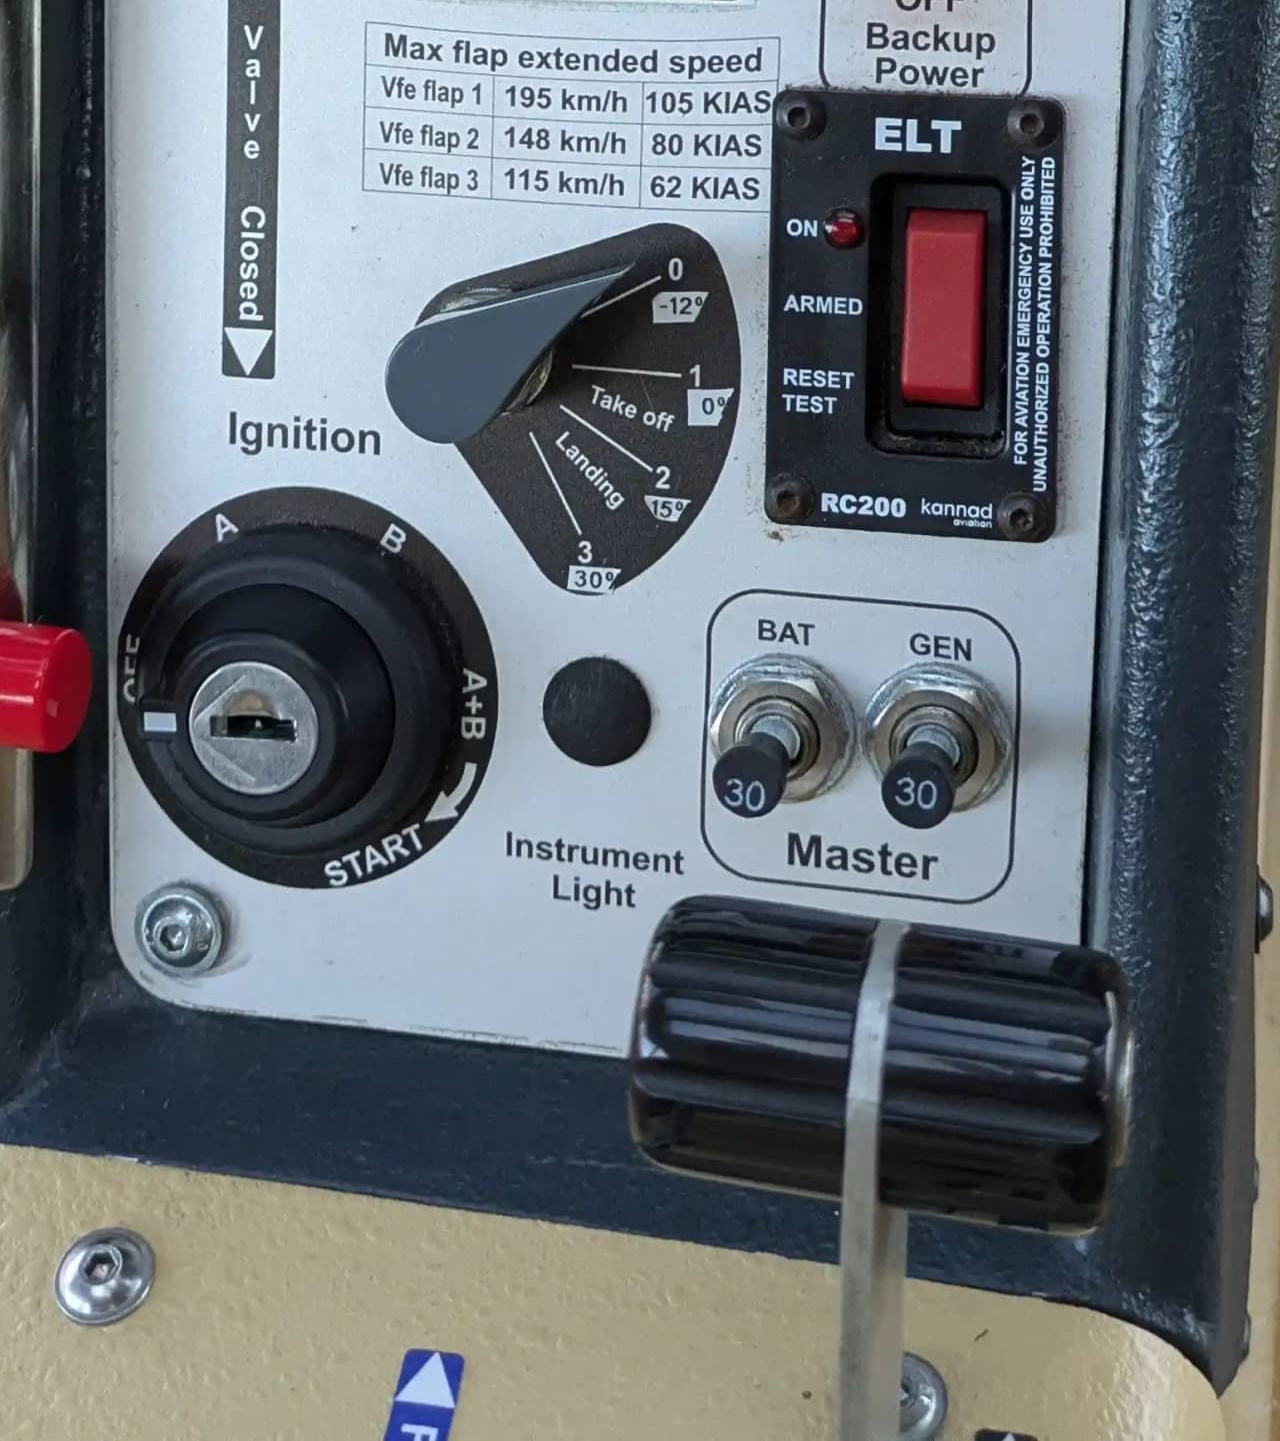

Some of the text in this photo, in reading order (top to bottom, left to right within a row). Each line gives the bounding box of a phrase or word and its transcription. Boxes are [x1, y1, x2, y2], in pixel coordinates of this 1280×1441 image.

[384, 33, 762, 79] Max flap extended speed
[866, 22, 996, 56] Backup
[875, 57, 984, 88] Power
[381, 75, 771, 114] Vfe flap 1 195 km/h 105 KIAS
[379, 121, 762, 157] Vfe flap 2 148 km/h 80 KIAS
[874, 118, 962, 153] ELT
[379, 163, 760, 200] Vfe flap 3 115 km/h 62 KIAS
[786, 219, 818, 237] ON
[239, 206, 266, 321] Closed
[669, 258, 683, 281] 0
[784, 295, 863, 315] ARMED
[1014, 155, 1036, 465] FOR AVIATION EMERGENCY USE ONLY
[1033, 156, 1056, 492] UNAUTHORIZED OPERATION PROHIBITED
[689, 364, 701, 387] 1
[783, 369, 855, 389] RESET
[591, 384, 675, 433] Take off
[782, 395, 837, 414] TEST
[228, 411, 382, 455] Ignition
[555, 430, 625, 511] Landing
[656, 466, 670, 489] 2
[820, 492, 992, 519] RC200 kannad
[214, 512, 240, 542] A
[379, 523, 407, 556] B
[953, 518, 992, 528] aviation
[577, 541, 592, 564] 3
[757, 618, 815, 647] BAT
[909, 632, 973, 662] GEN
[460, 668, 488, 740] A+B
[724, 778, 765, 812] 30
[894, 777, 937, 810] 30
[323, 822, 424, 888] START
[505, 830, 685, 875] Instrument
[786, 831, 939, 881] Master
[552, 873, 636, 911] Light
